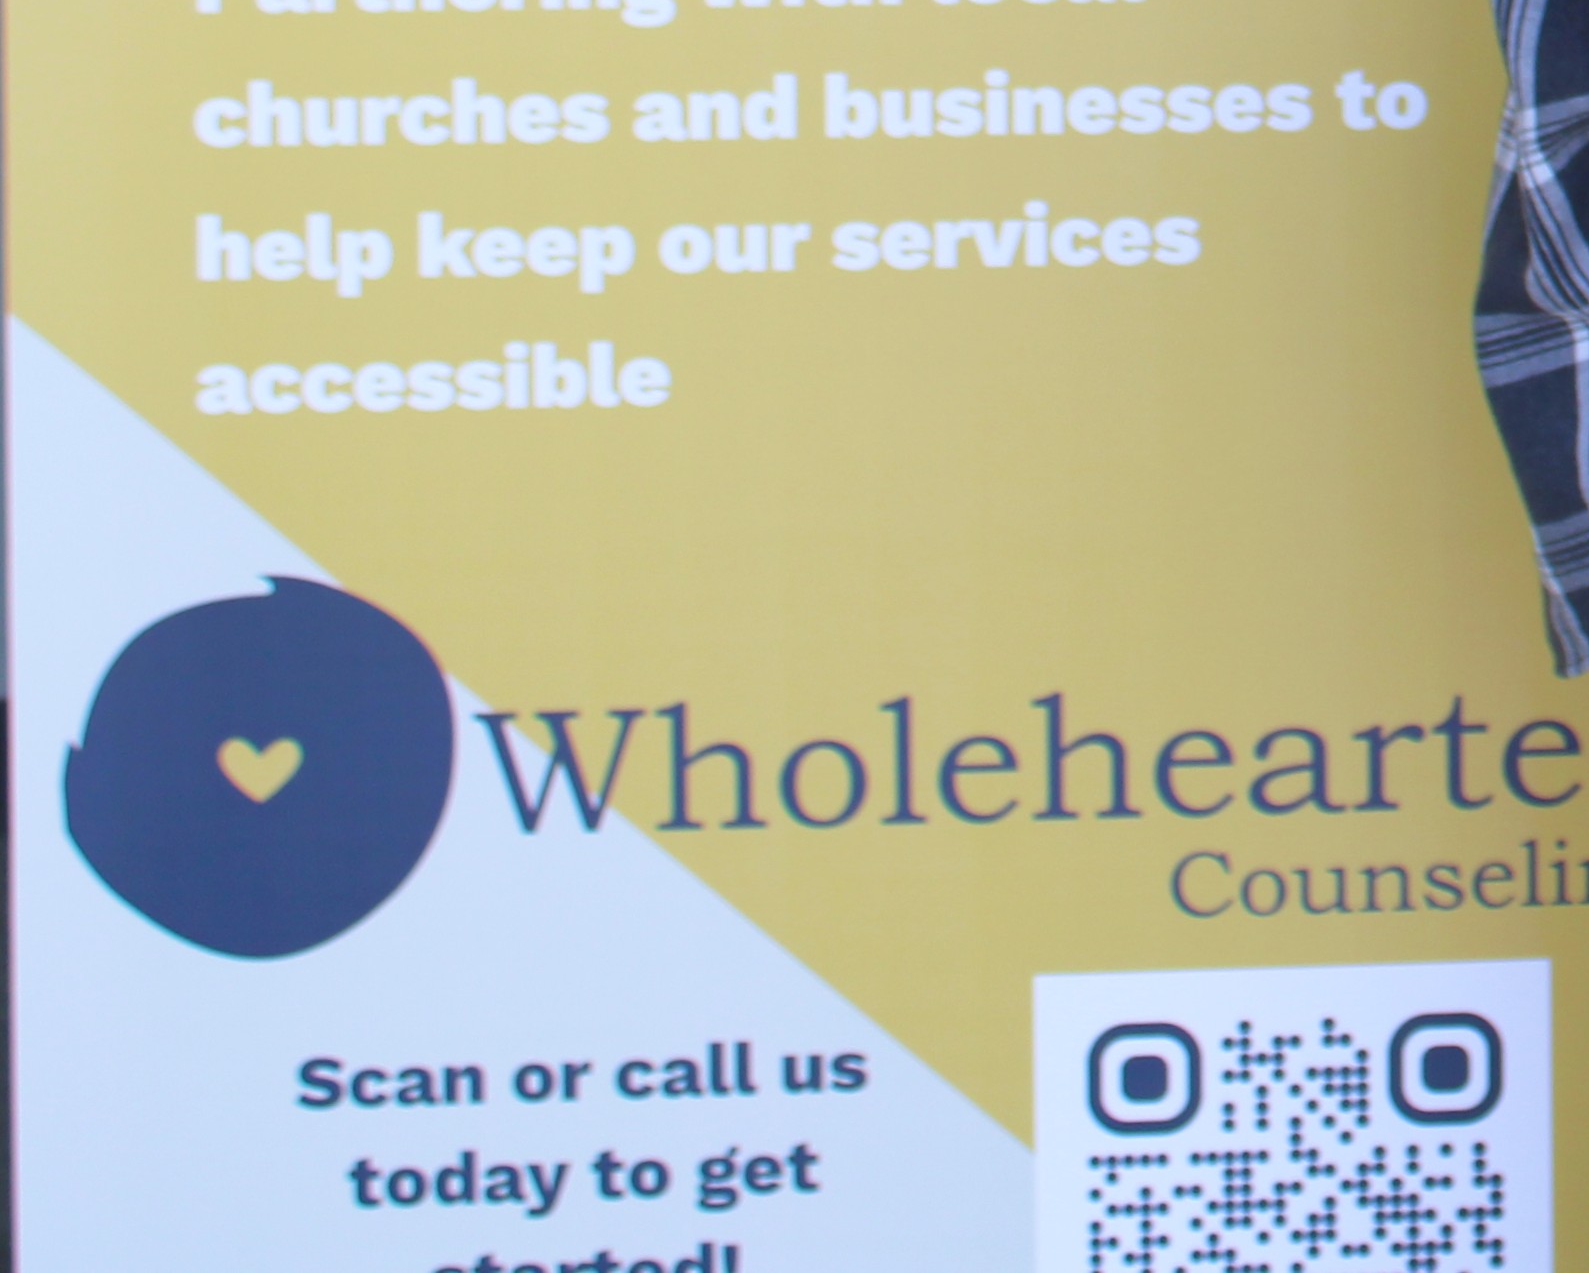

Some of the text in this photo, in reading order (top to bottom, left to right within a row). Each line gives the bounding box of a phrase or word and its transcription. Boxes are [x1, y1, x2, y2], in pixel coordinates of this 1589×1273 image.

[193, 68, 1429, 149] churches and businesses to
[196, 199, 1202, 298] help keep our services
[195, 339, 672, 415] accessible
[298, 1041, 866, 1109] Scan or call us
[346, 1144, 818, 1220] today to get
